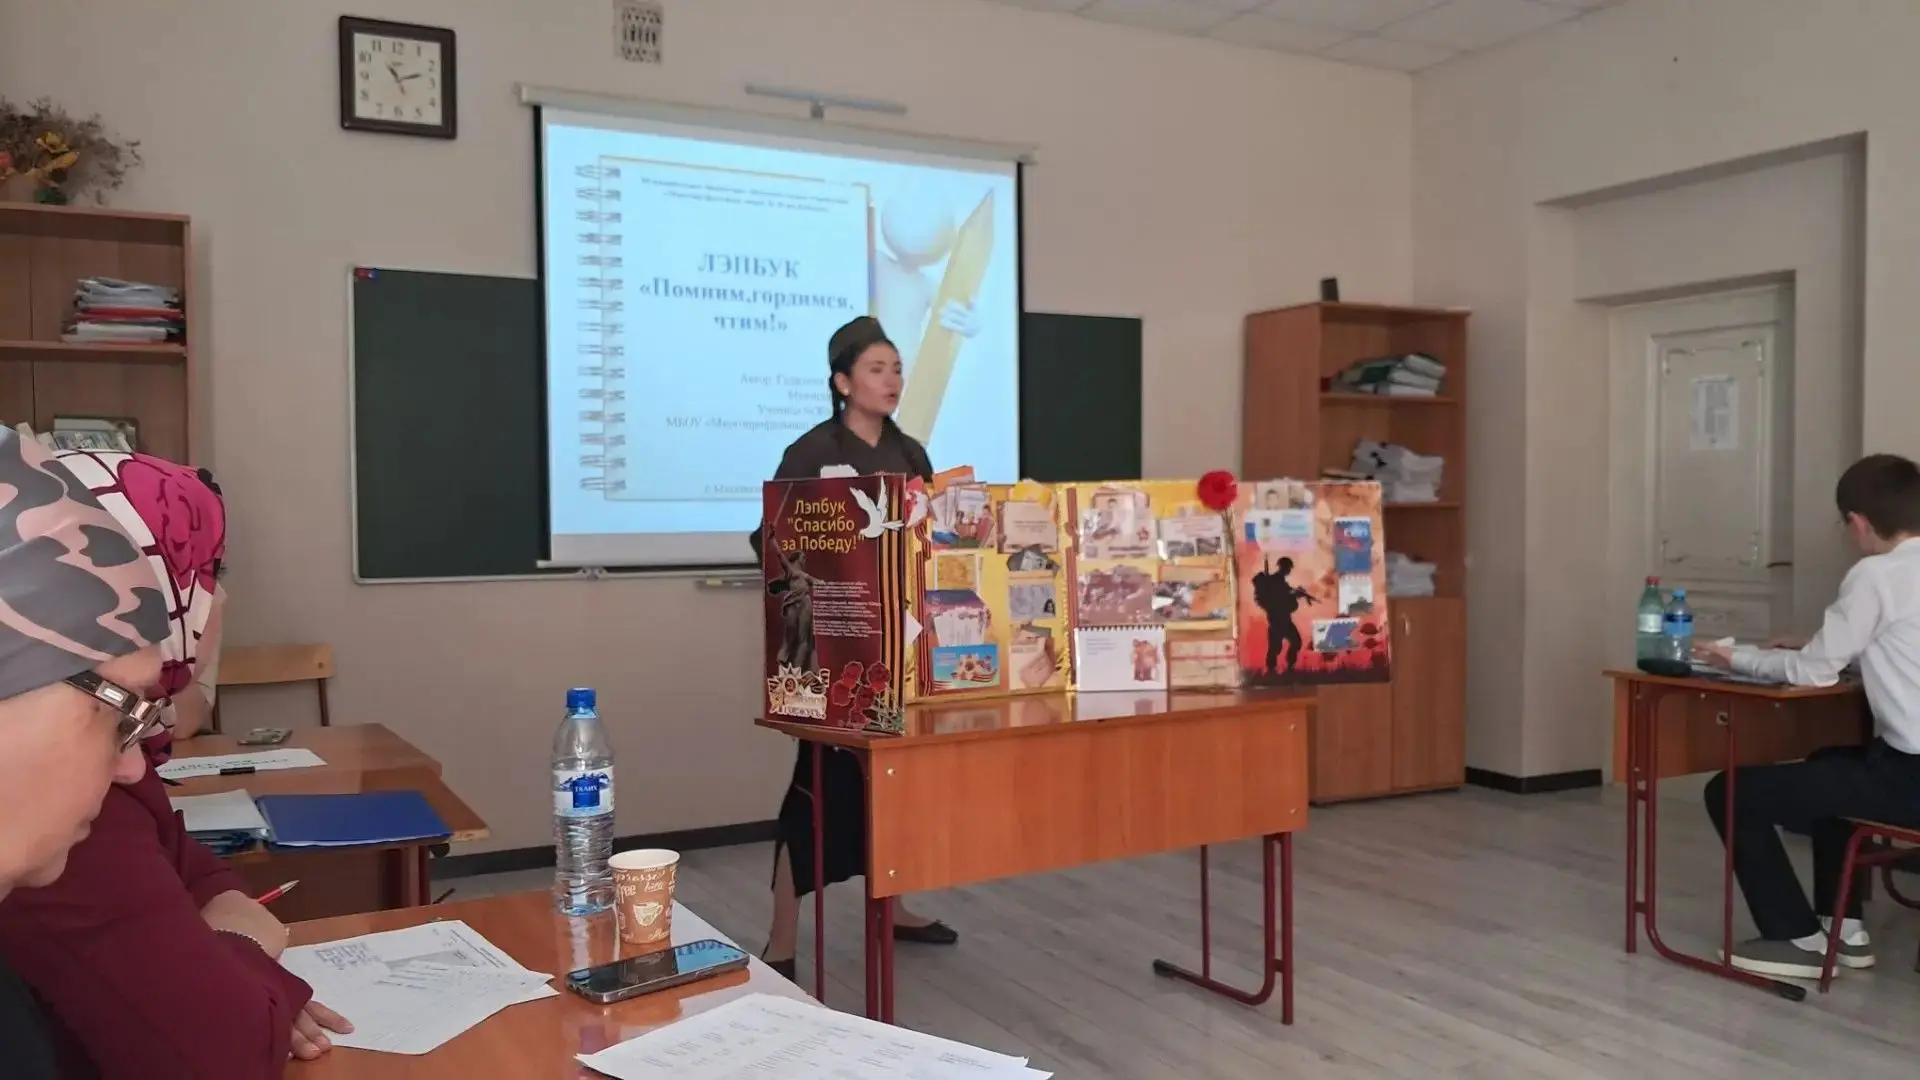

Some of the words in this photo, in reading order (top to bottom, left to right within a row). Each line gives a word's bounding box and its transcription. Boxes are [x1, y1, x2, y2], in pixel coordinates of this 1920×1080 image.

[392, 40, 405, 55] 12
[697, 253, 800, 279] ЛЭПБУК
[713, 312, 788, 332] чтим!»
[794, 498, 846, 517] Лэпбук
[787, 515, 855, 533] "Спасибо
[780, 539, 796, 551] за
[800, 533, 865, 554] Победу!"
